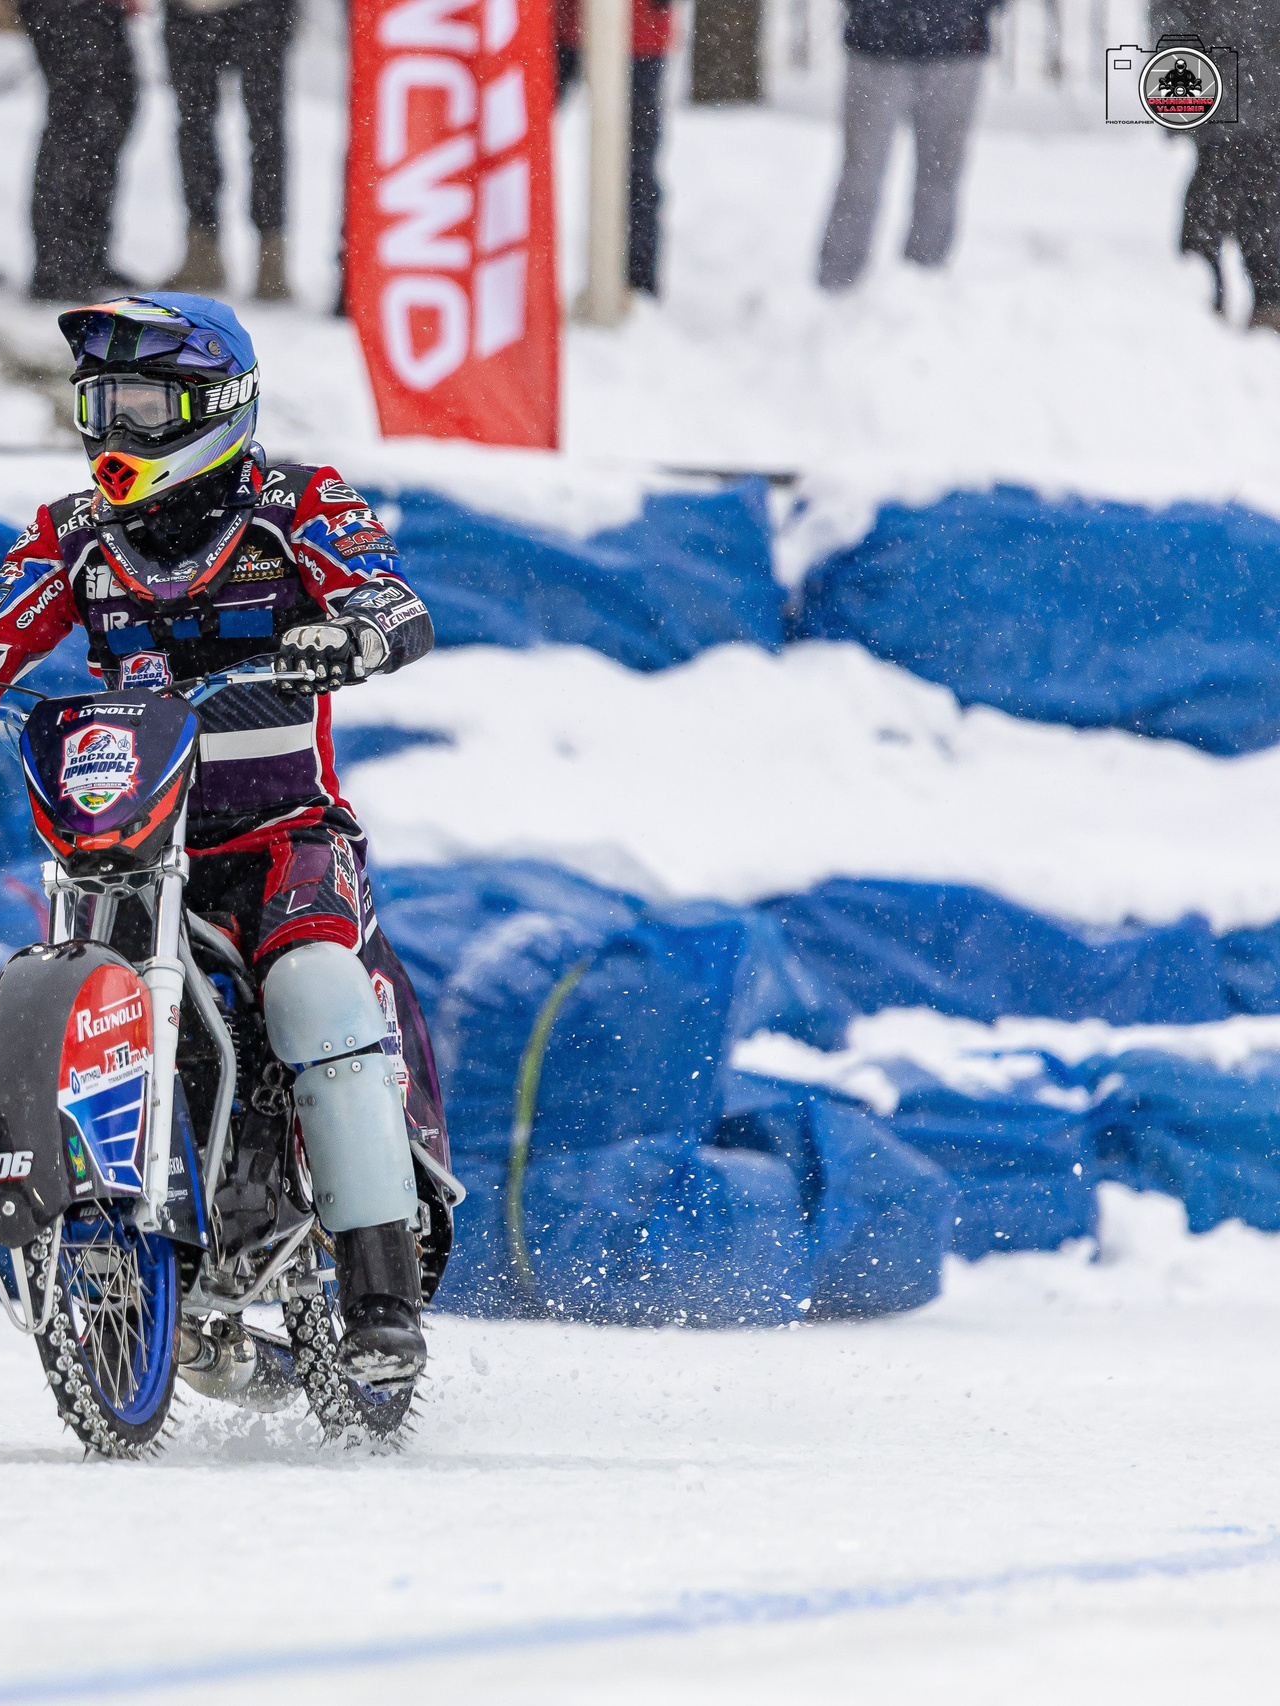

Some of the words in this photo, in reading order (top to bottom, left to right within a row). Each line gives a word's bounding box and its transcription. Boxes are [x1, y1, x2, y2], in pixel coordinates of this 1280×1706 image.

[205, 514, 243, 567] RELYNOLLI
[232, 560, 280, 573] N1KOV
[30, 579, 65, 615] WACO
[57, 704, 146, 726] RELYNOLLI
[70, 752, 127, 766] ВОСХОД
[63, 761, 135, 780] ПРИМОРЬЕ
[77, 1001, 142, 1042] RELYNOLLI
